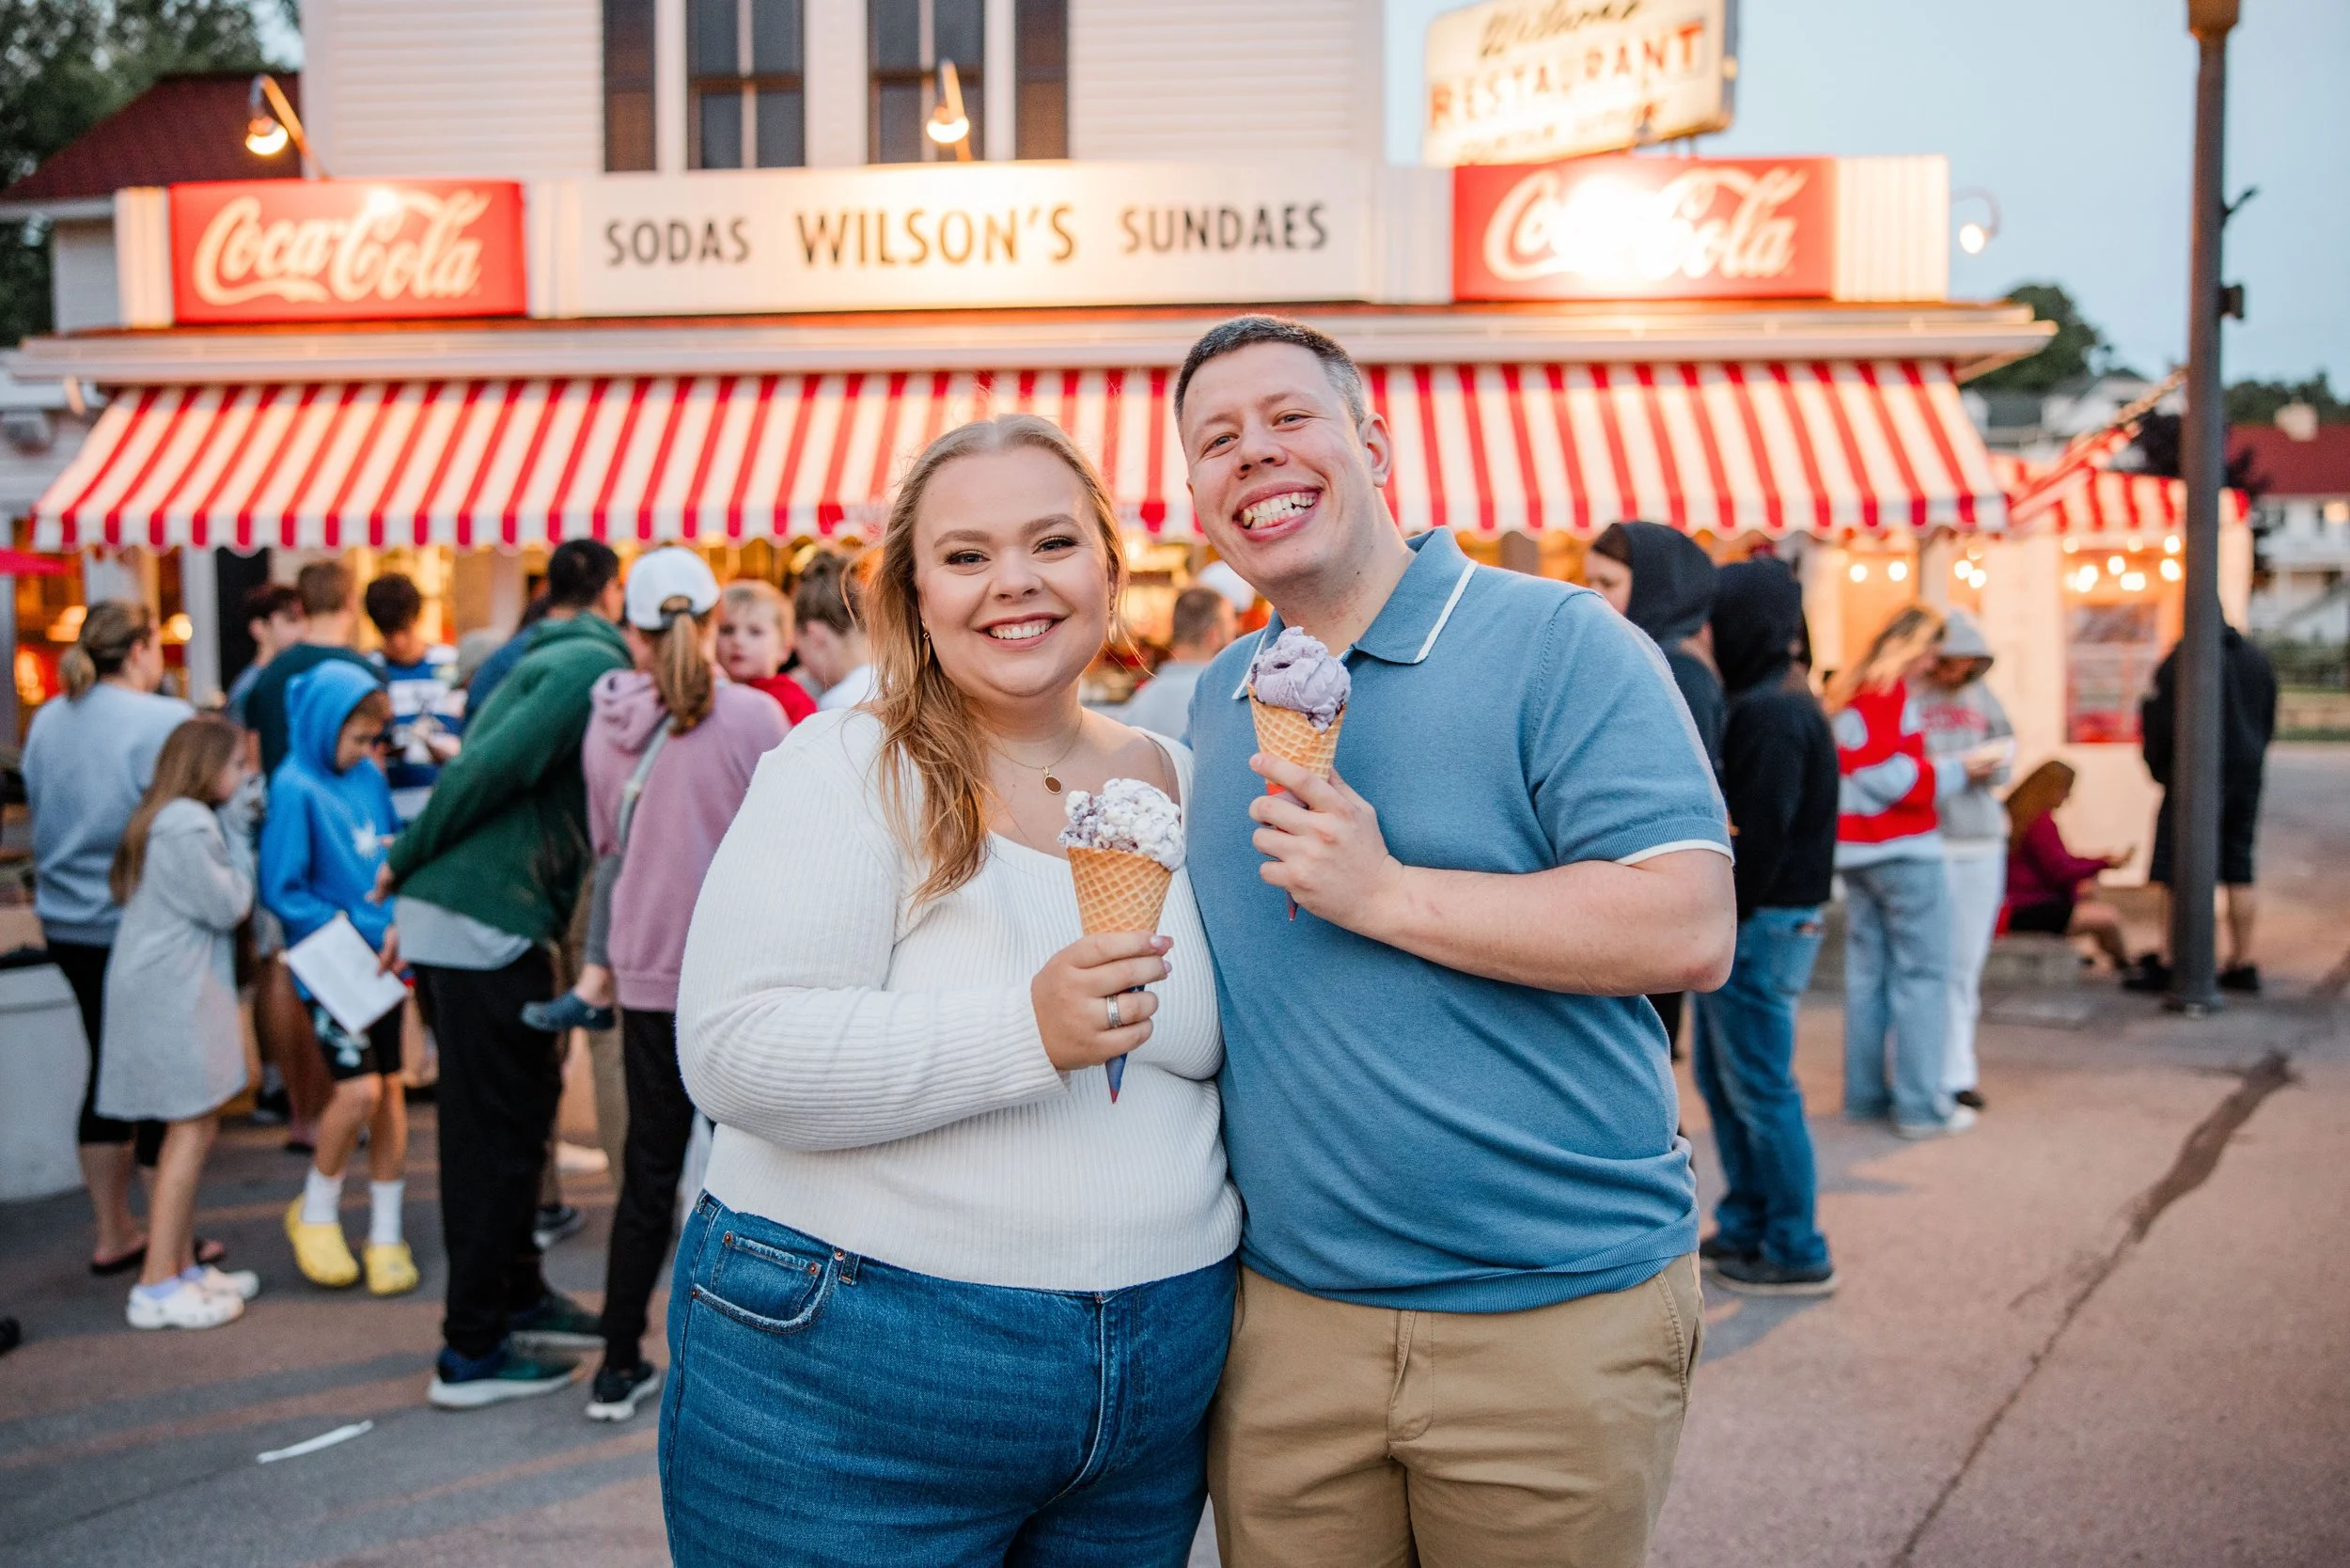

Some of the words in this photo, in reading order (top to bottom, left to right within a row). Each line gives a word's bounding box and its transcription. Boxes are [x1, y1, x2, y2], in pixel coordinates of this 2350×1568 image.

[605, 216, 750, 265] SODAS
[796, 208, 1075, 264] WILSON'S
[1120, 200, 1328, 254] SUNDAES
[1483, 168, 1808, 281] CoCola
